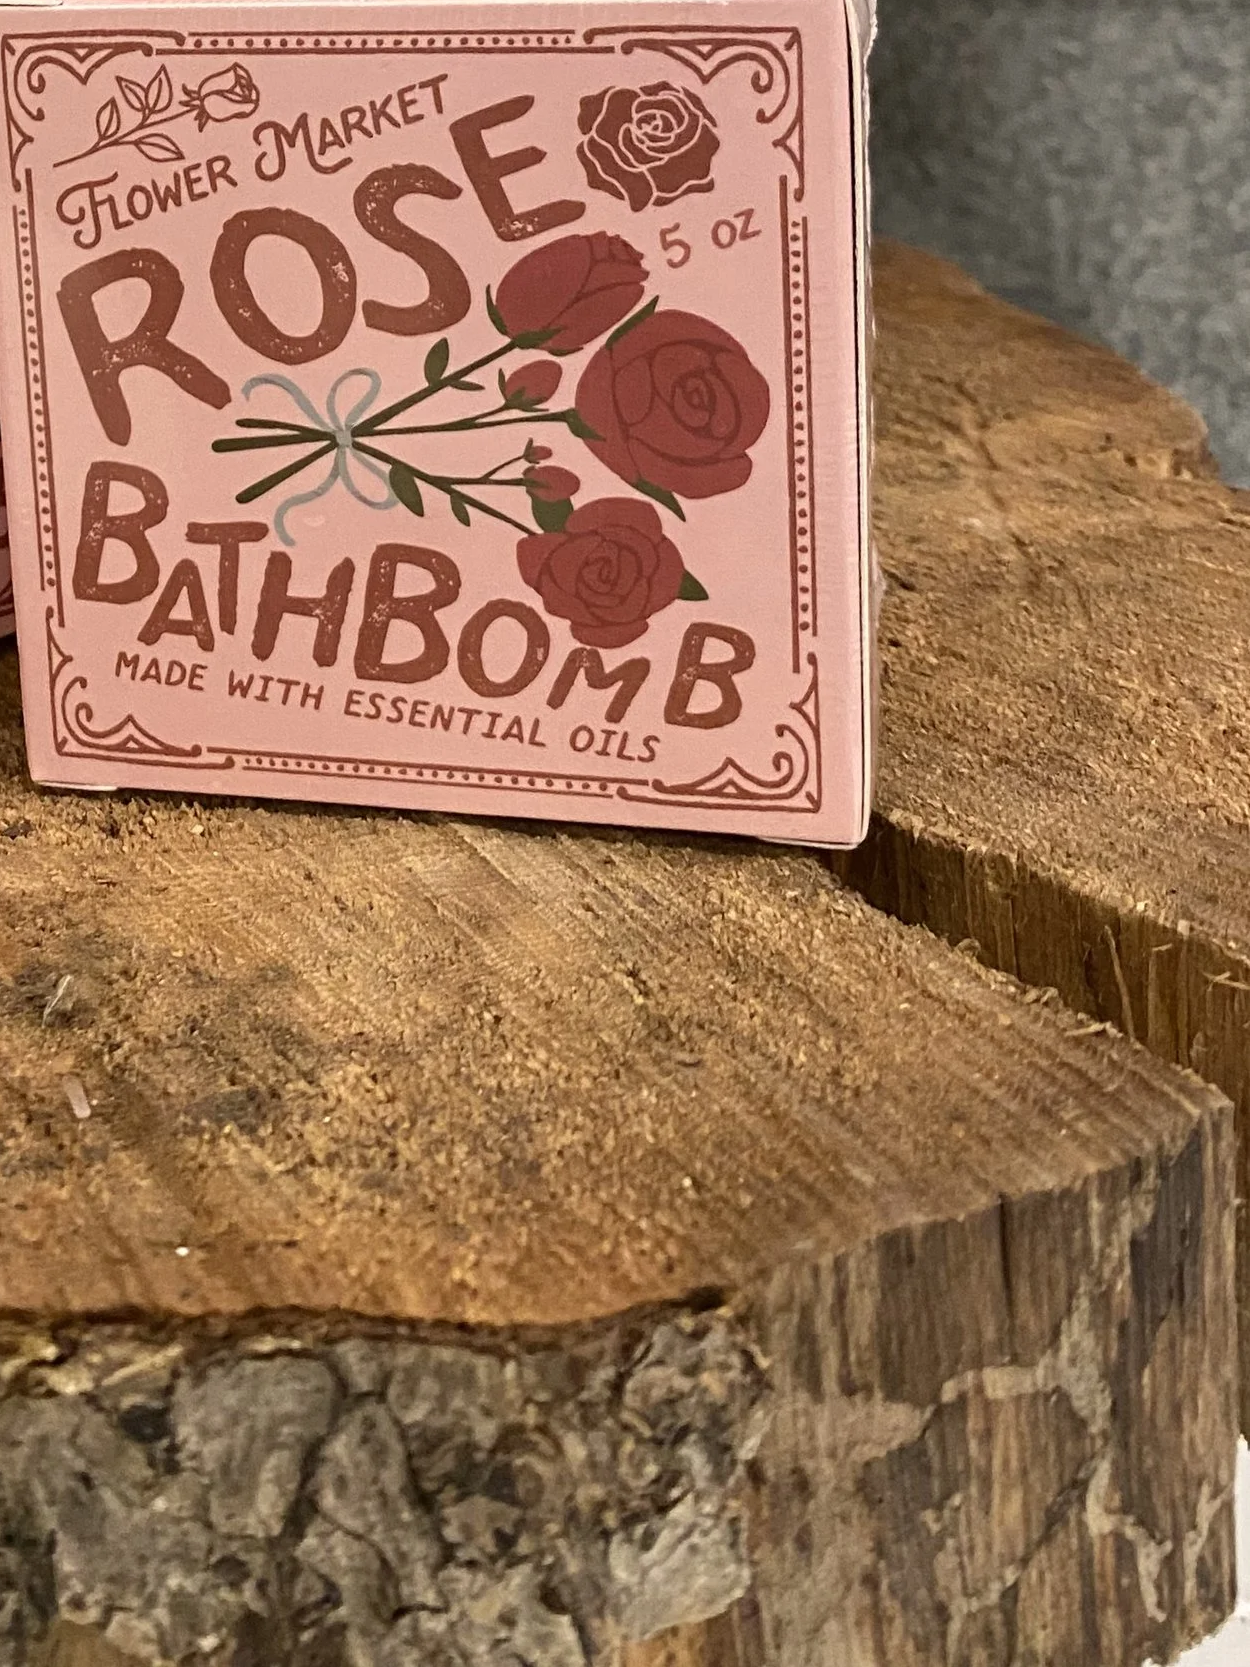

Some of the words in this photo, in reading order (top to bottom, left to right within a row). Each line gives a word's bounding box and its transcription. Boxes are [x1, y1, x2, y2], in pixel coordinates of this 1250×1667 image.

[56, 155, 238, 250] FLOWER
[255, 74, 449, 181] MARKET
[660, 225, 691, 270] 5
[56, 94, 587, 446] ROSE
[73, 460, 758, 730] BATHBOMB
[115, 650, 209, 693] MADE
[226, 672, 325, 712] WITH
[343, 687, 548, 751] ESSENTIAL
[568, 724, 662, 765] OILS
